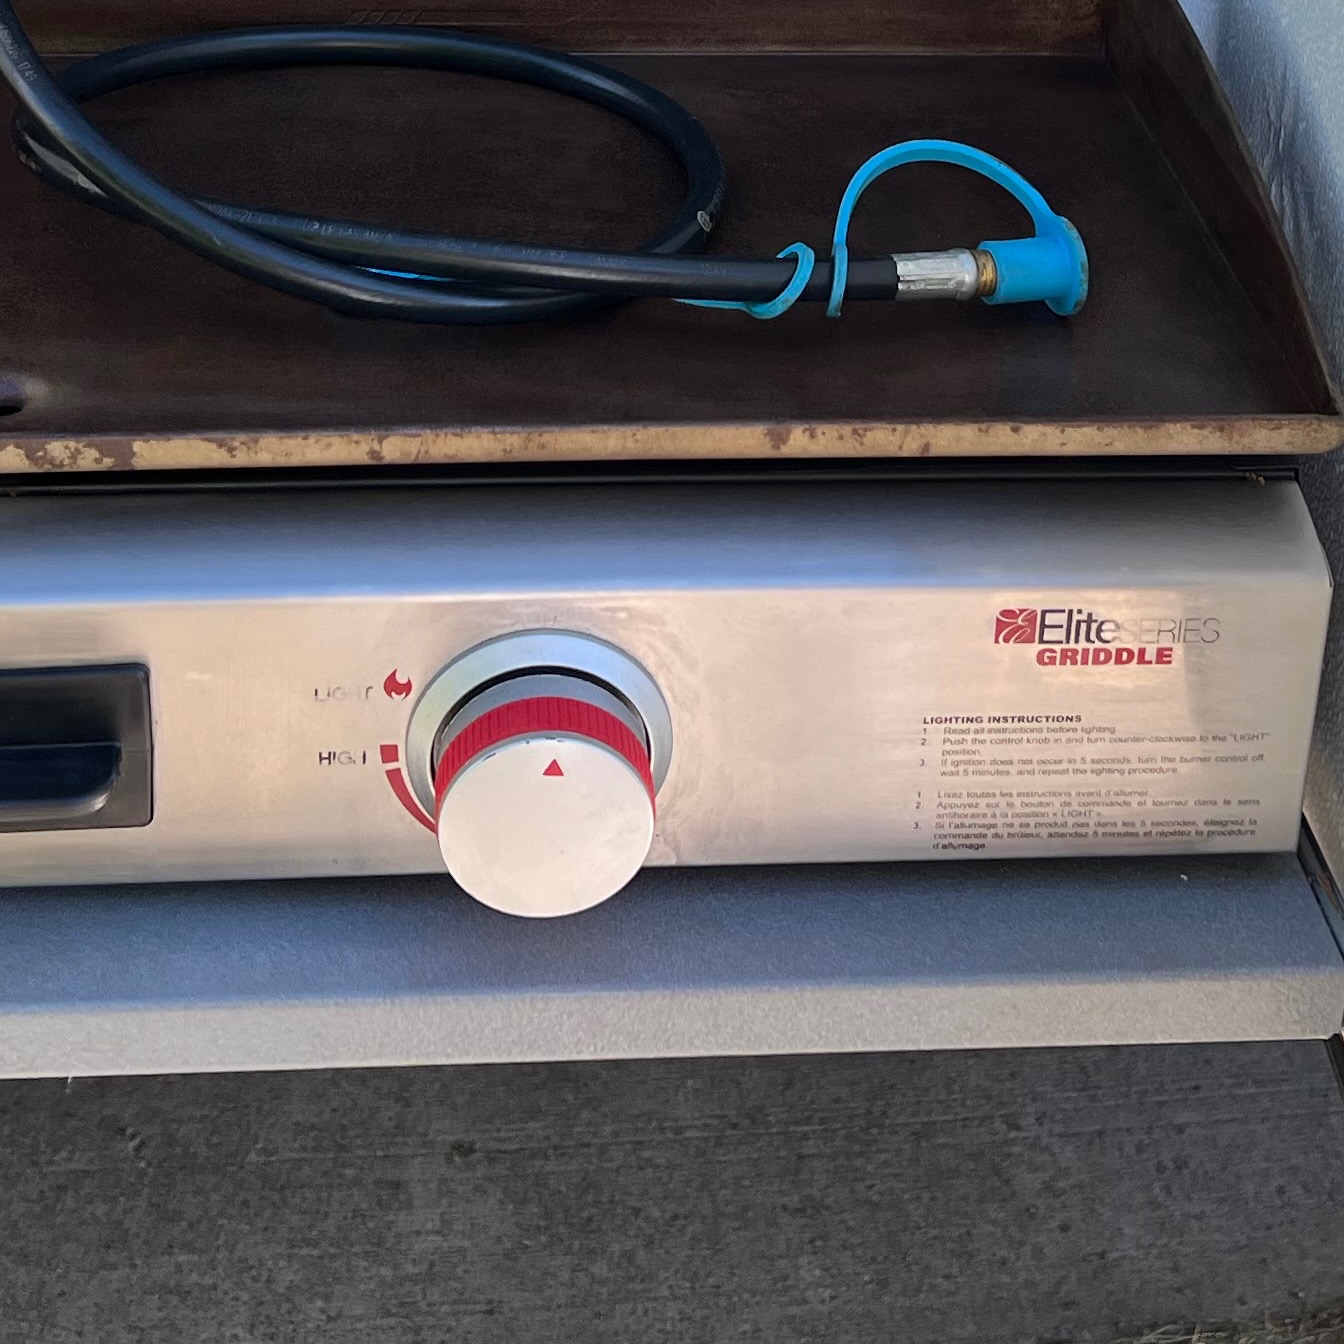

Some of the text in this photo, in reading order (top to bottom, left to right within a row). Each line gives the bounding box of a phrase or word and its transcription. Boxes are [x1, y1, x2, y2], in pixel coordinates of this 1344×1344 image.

[1036, 647, 1174, 666] GRIDDLE
[923, 715, 1082, 724] LIGHTING INSTRUCTIONS
[944, 727, 971, 735] Read
[987, 726, 1044, 734] instructions
[1047, 726, 1078, 734] before
[943, 737, 968, 745] Push
[971, 737, 987, 745] the
[990, 737, 1024, 745] control
[1065, 736, 1084, 744] and
[1108, 735, 1196, 744] counter-clockwise
[1199, 734, 1208, 743] to
[1211, 734, 1227, 742] the
[951, 758, 986, 767] ignition
[990, 758, 1014, 766] does
[1161, 755, 1176, 763] the
[1179, 755, 1211, 763] burner
[1215, 754, 1248, 763] control
[940, 768, 960, 777] wait
[1016, 768, 1035, 776] and
[1038, 767, 1070, 776] repeat
[1072, 767, 1088, 775] the
[1090, 766, 1125, 776] lighting
